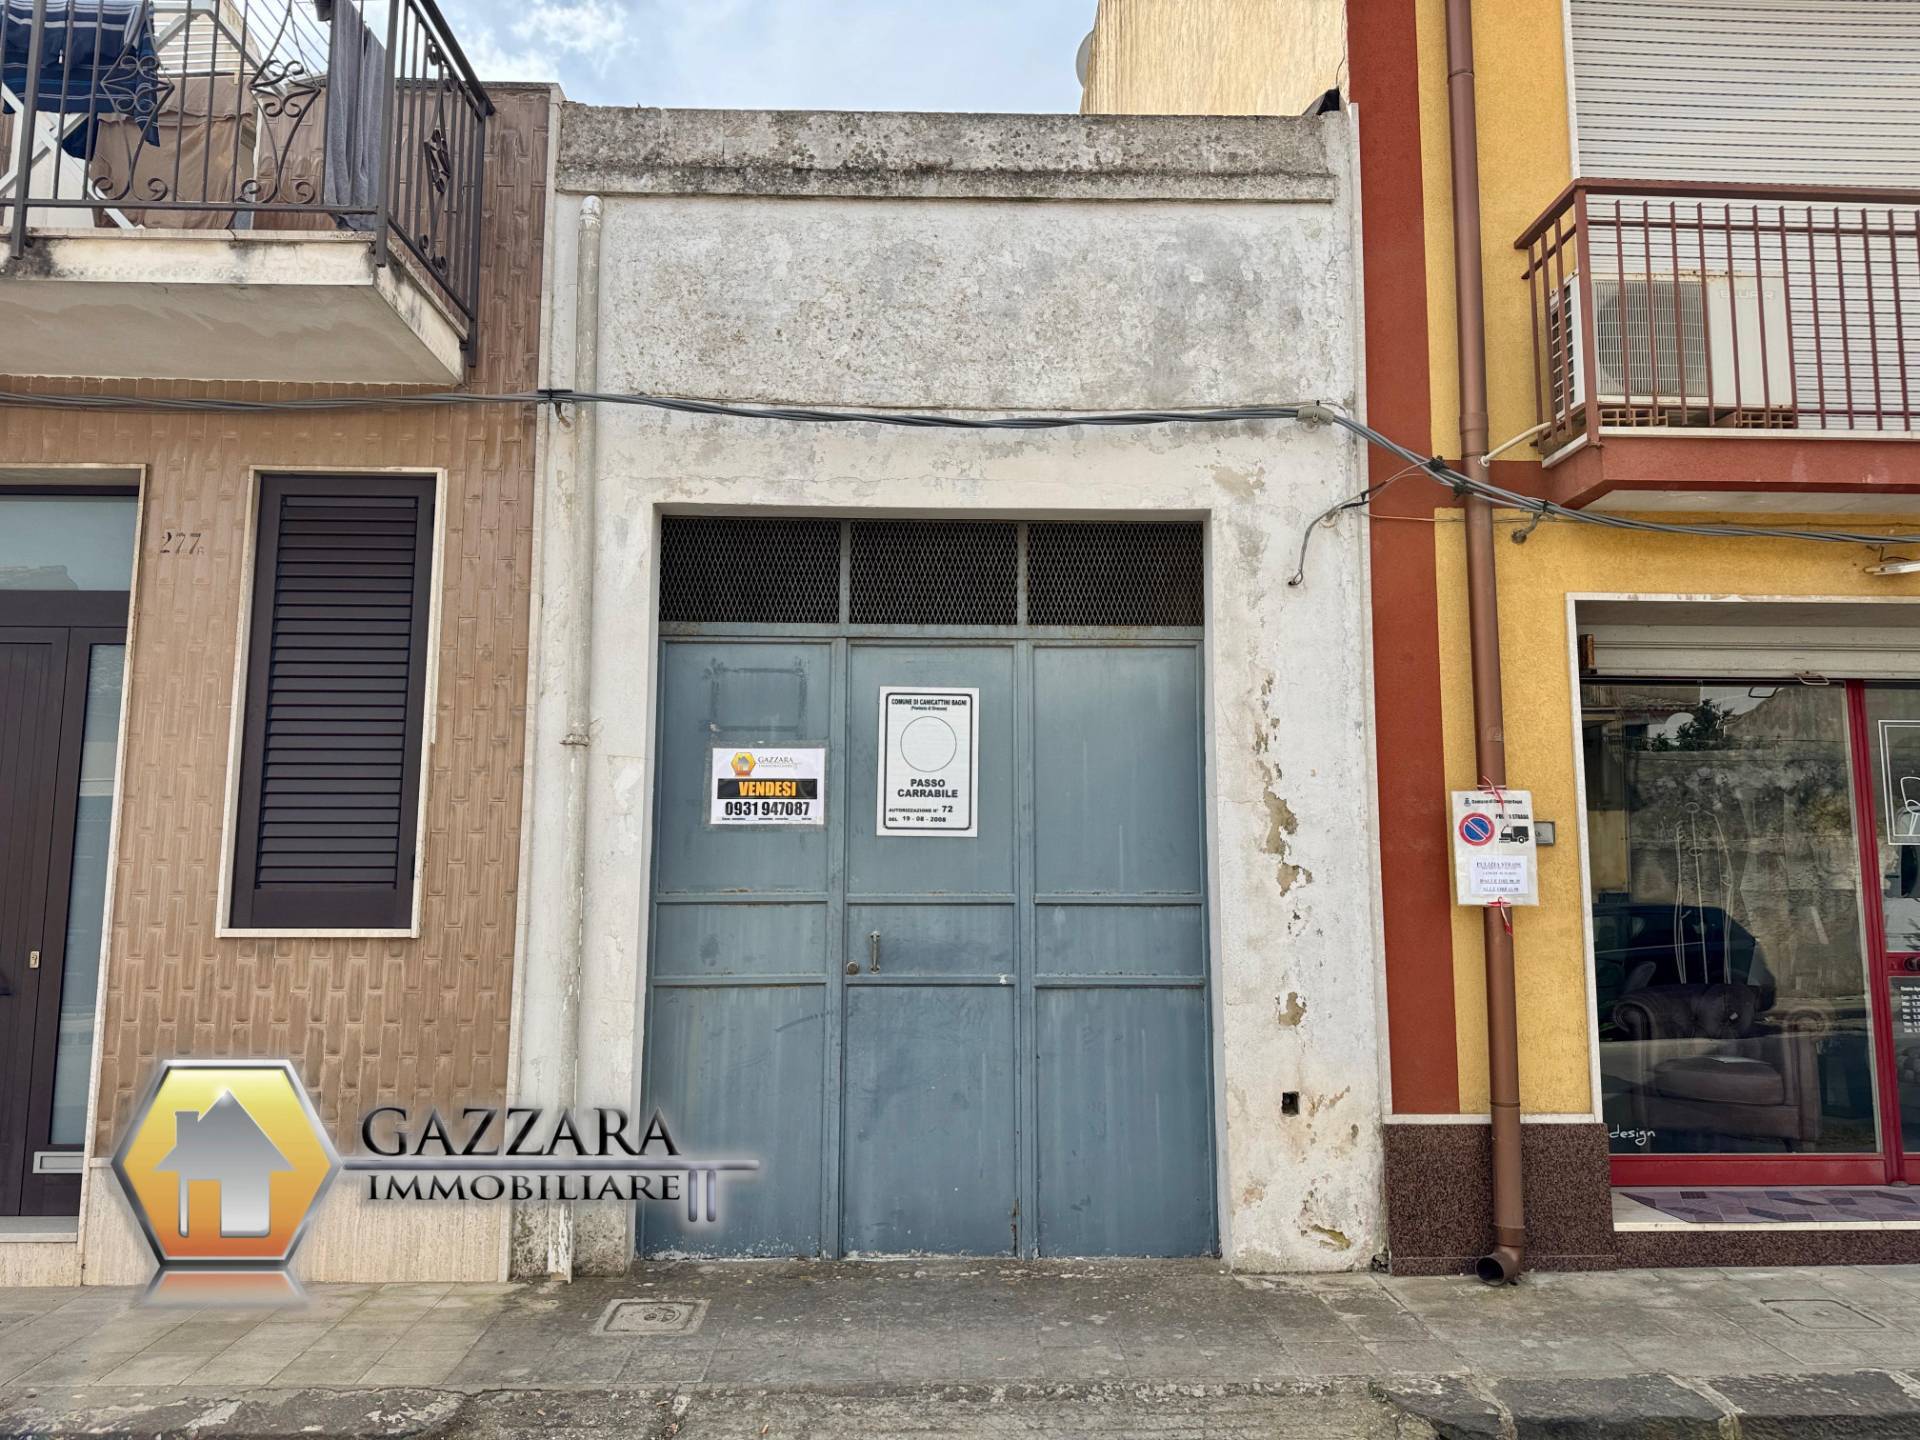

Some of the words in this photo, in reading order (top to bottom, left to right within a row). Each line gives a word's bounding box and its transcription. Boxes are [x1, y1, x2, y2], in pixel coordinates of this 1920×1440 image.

[919, 698, 950, 706] CANICATTINI
[757, 756, 794, 764] GAZZARA
[910, 778, 946, 788] PASSO
[738, 781, 797, 797] VENDESI
[897, 788, 958, 798] CARRABILE
[725, 801, 758, 816] 0931
[761, 801, 810, 816] 947087
[941, 805, 953, 813] 72
[1608, 1123, 1656, 1146] design
